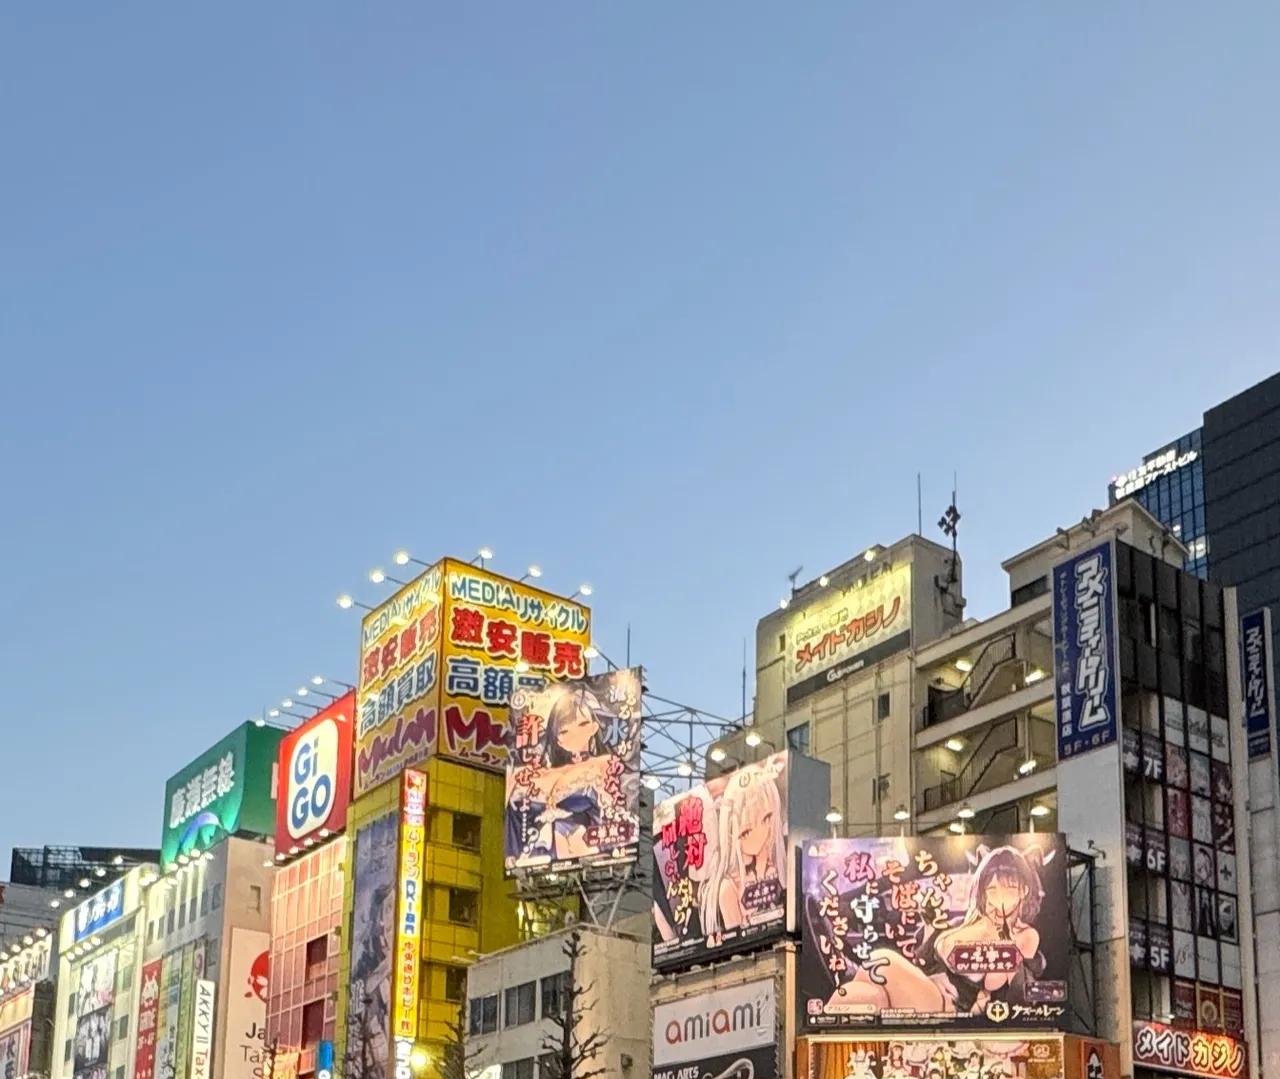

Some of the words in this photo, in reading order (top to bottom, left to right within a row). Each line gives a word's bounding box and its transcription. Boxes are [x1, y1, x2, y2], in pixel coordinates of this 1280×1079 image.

[364, 608, 438, 683] 激安販売
[451, 606, 584, 678] 激安販売
[1075, 553, 1110, 731] アメニティドリーム
[361, 654, 436, 733] 高額買取
[169, 762, 235, 829] 廣瀬無線
[1143, 756, 1163, 778] 7F
[914, 850, 952, 930] ちゃんと
[1146, 849, 1166, 872] 6F
[844, 852, 891, 985] 私に守らせて
[1150, 947, 1171, 969] 5F
[197, 984, 213, 1031] AKKY
[666, 1000, 762, 1045] amiami
[1136, 1026, 1246, 1076] メイドカジノ
